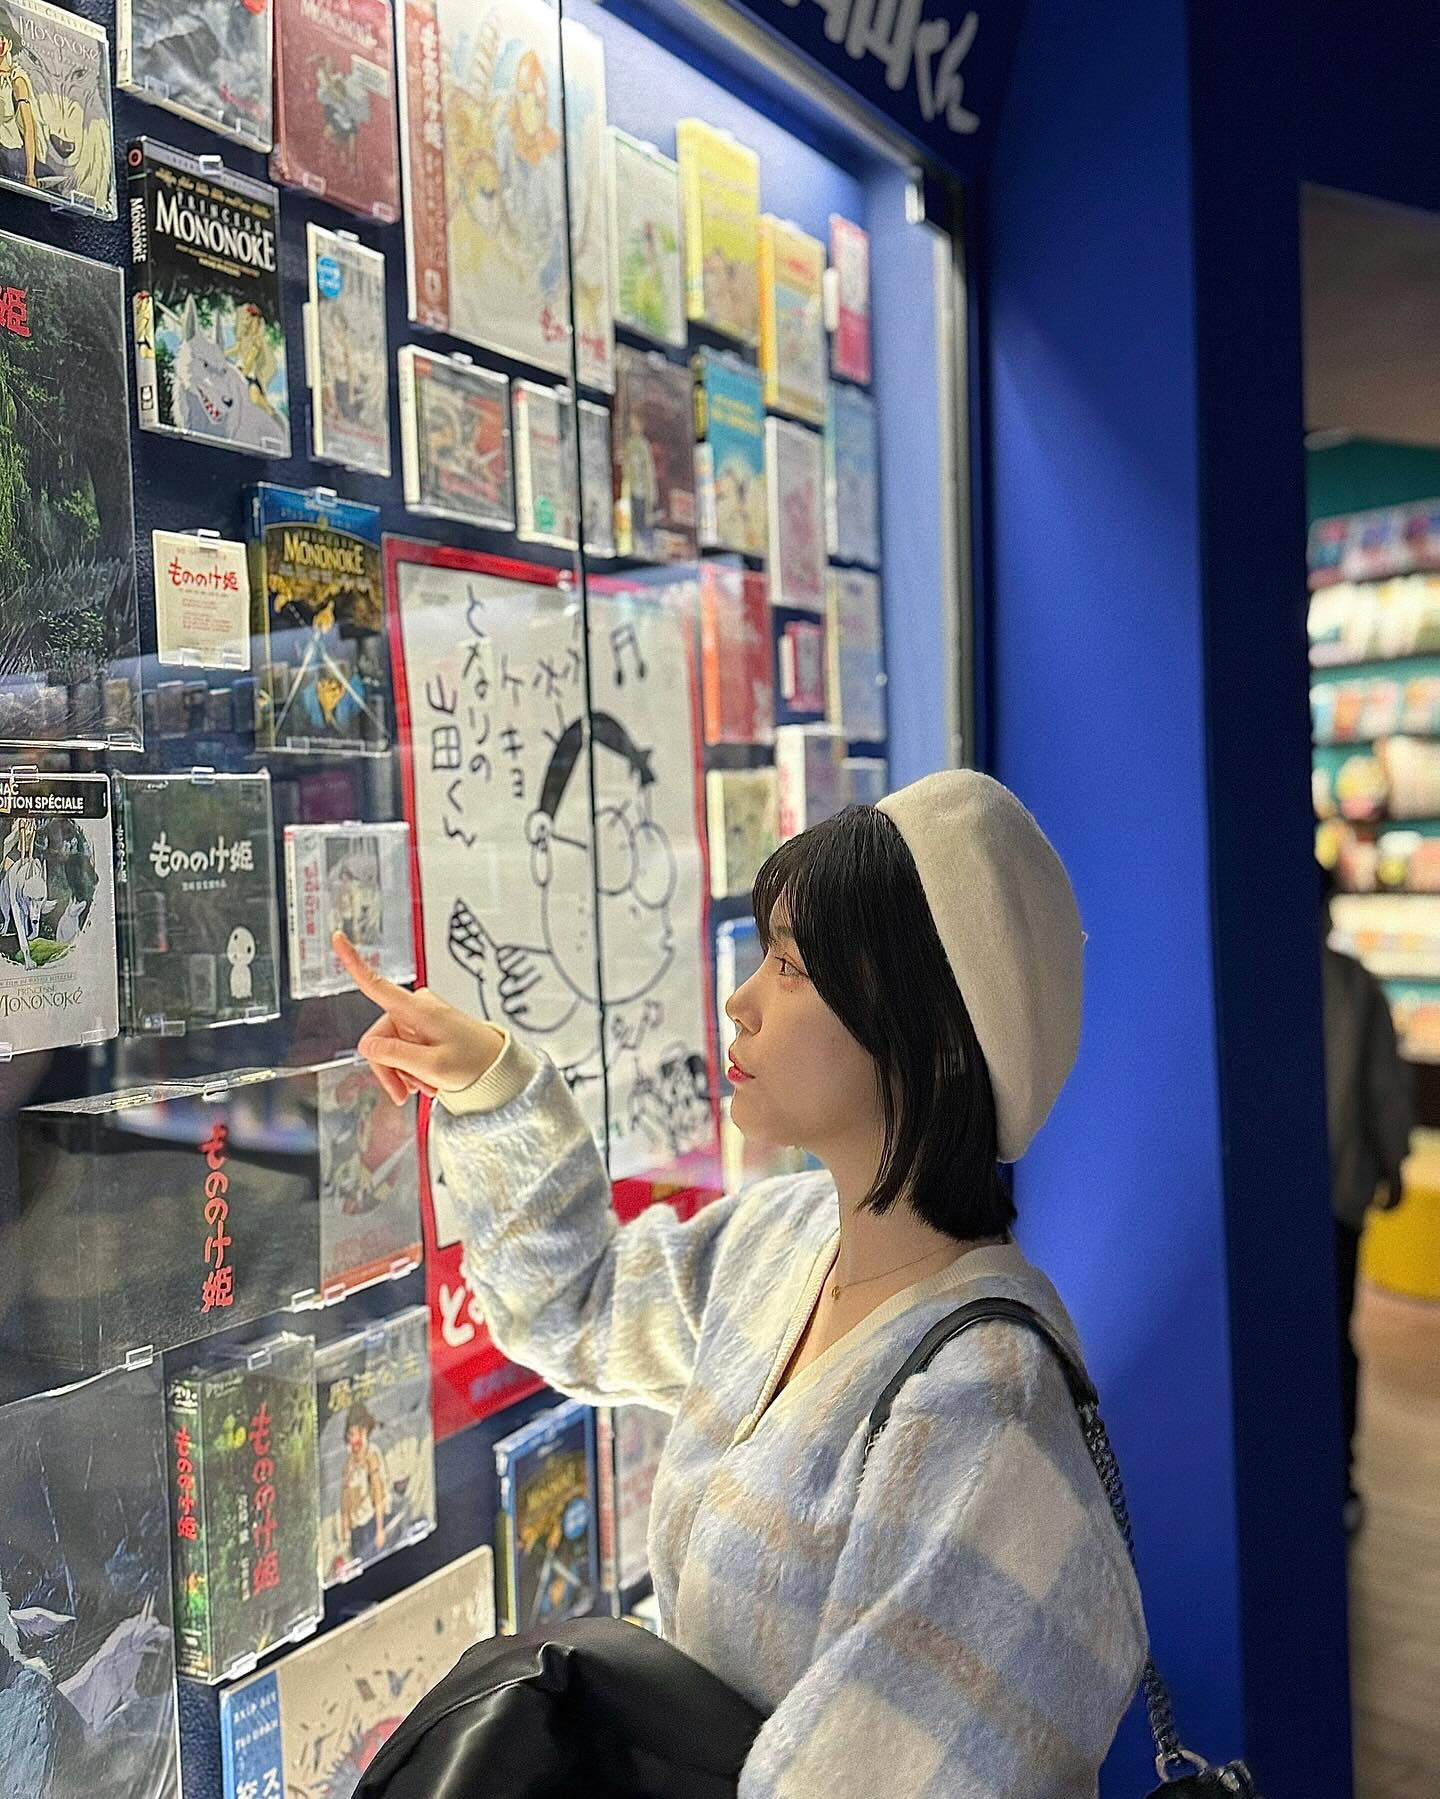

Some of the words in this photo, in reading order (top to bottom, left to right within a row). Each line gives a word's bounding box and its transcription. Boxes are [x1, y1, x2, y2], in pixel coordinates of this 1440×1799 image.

[155, 189, 277, 272] MONONOKE
[168, 556, 239, 592] もののけ姫
[283, 531, 365, 575] MONONOKE
[35, 793, 84, 810] SPÉCIALE
[149, 830, 255, 878] もののけ姫
[199, 1121, 234, 1313] もののけ姫
[174, 1423, 198, 1542] もののけ姫
[248, 1399, 281, 1598] もののけ姫
